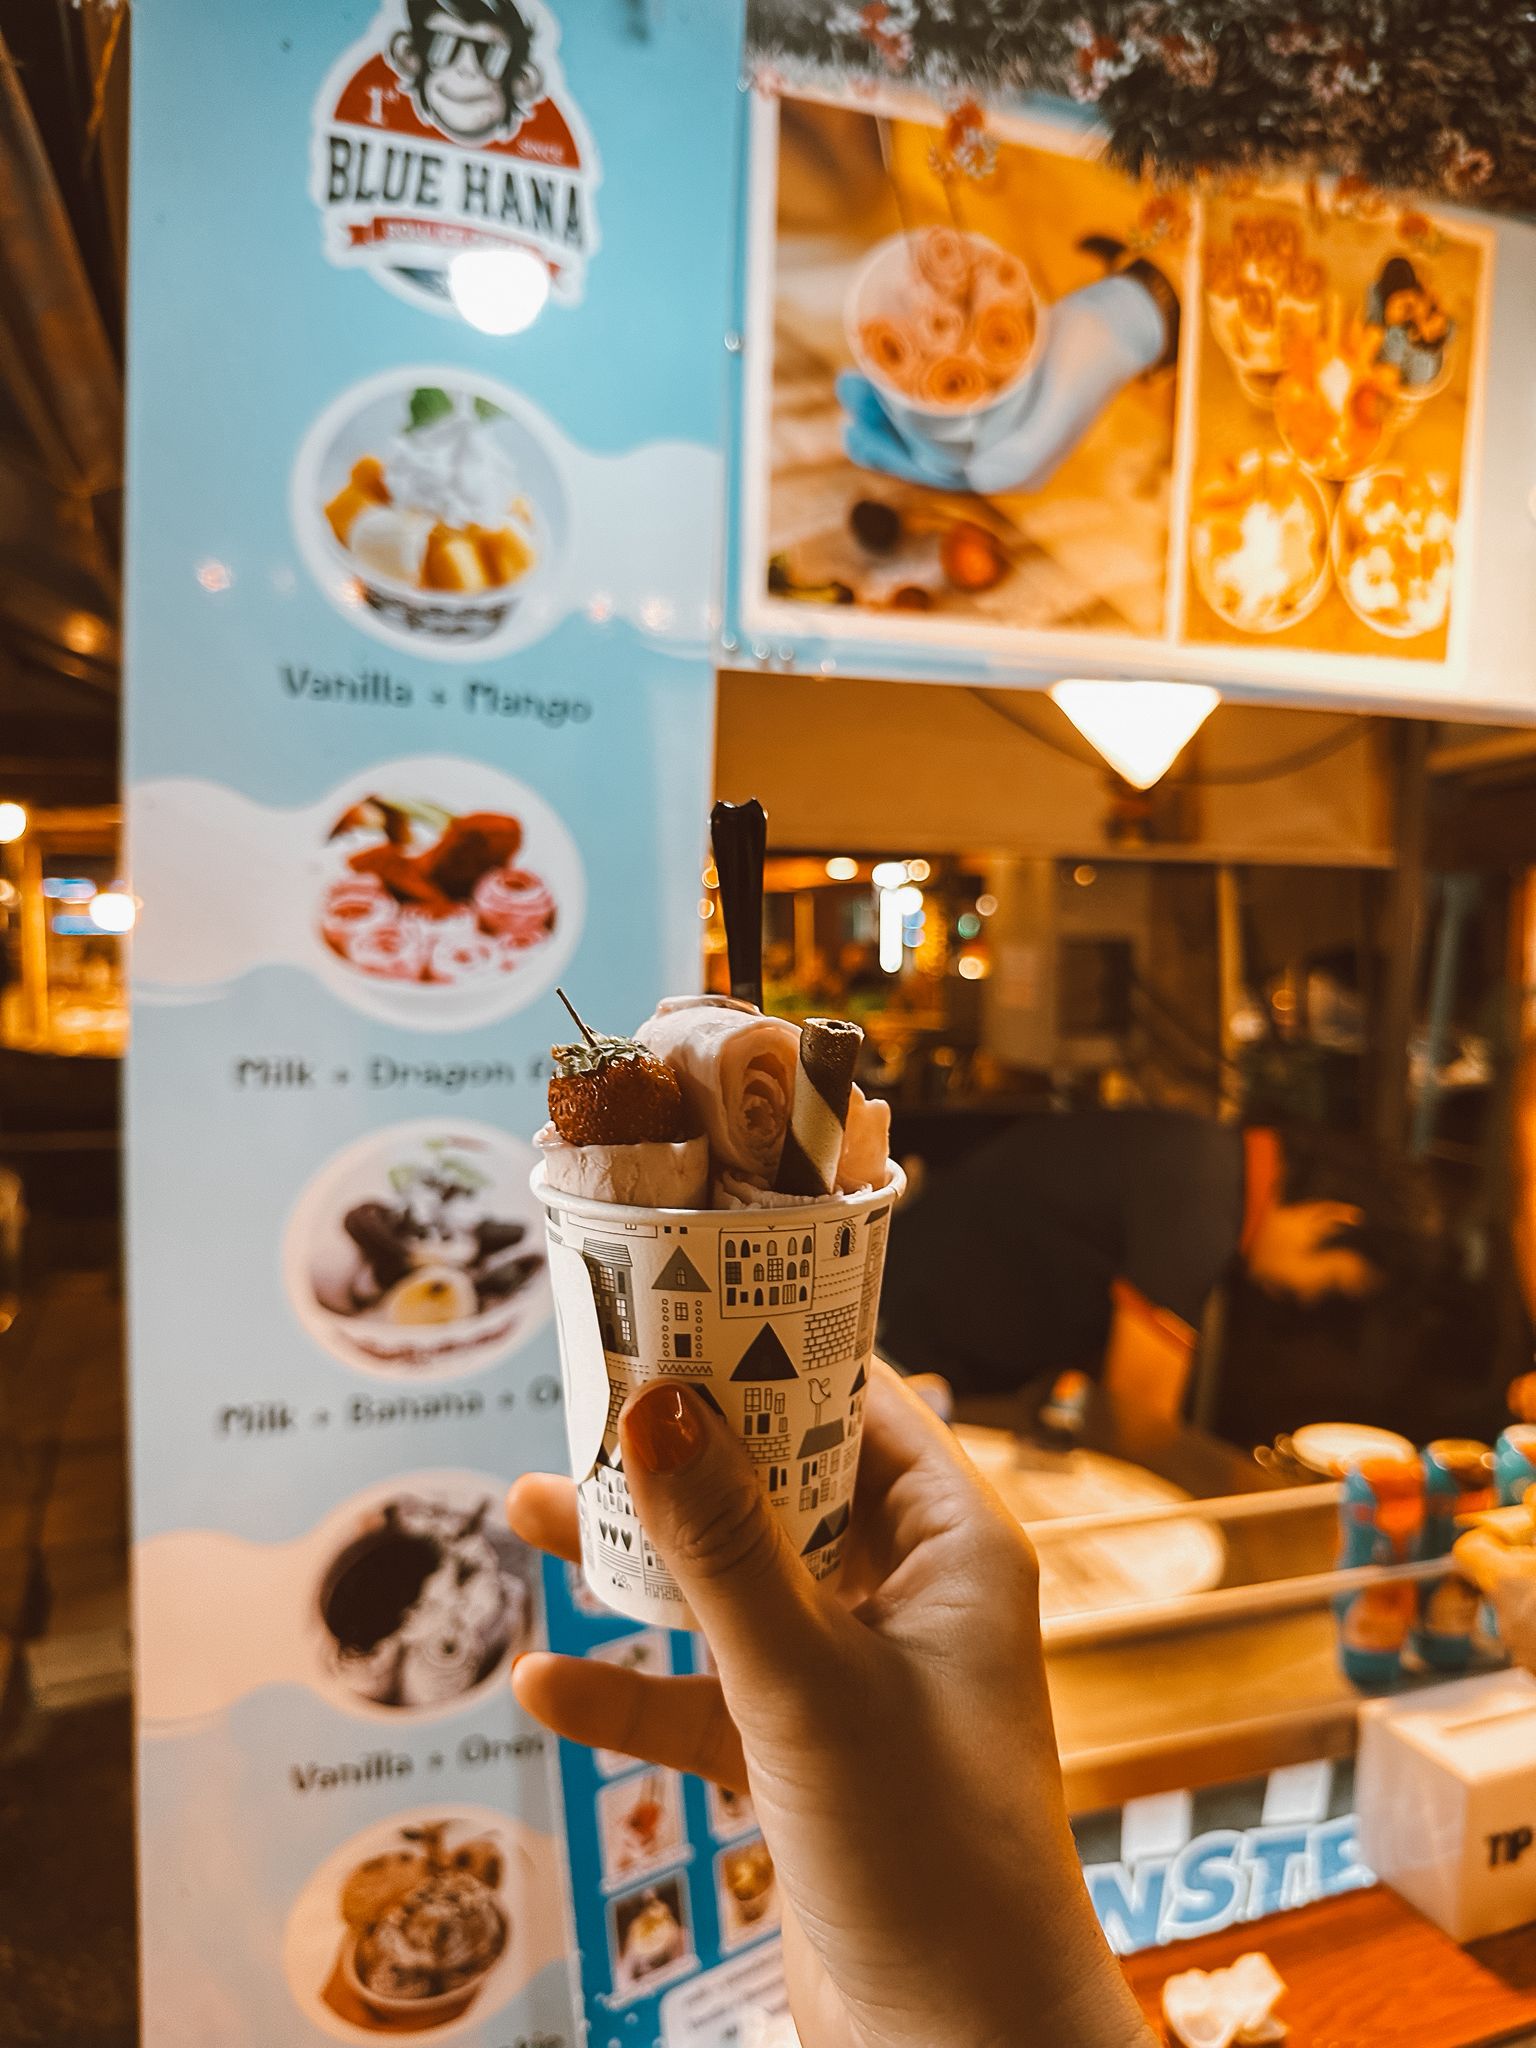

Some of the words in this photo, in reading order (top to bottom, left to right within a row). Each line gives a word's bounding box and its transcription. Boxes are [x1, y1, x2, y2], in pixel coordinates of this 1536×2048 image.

[327, 135, 444, 205] BLUE
[462, 163, 583, 250] HANA
[280, 661, 414, 709] Vanilla
[463, 676, 593, 730] Mango
[233, 1054, 317, 1092] Milk
[364, 1052, 517, 1096] Dragon
[217, 1399, 297, 1436] Milk
[288, 1750, 415, 1793] Vanilla
[1486, 1824, 1534, 1868] TIP
